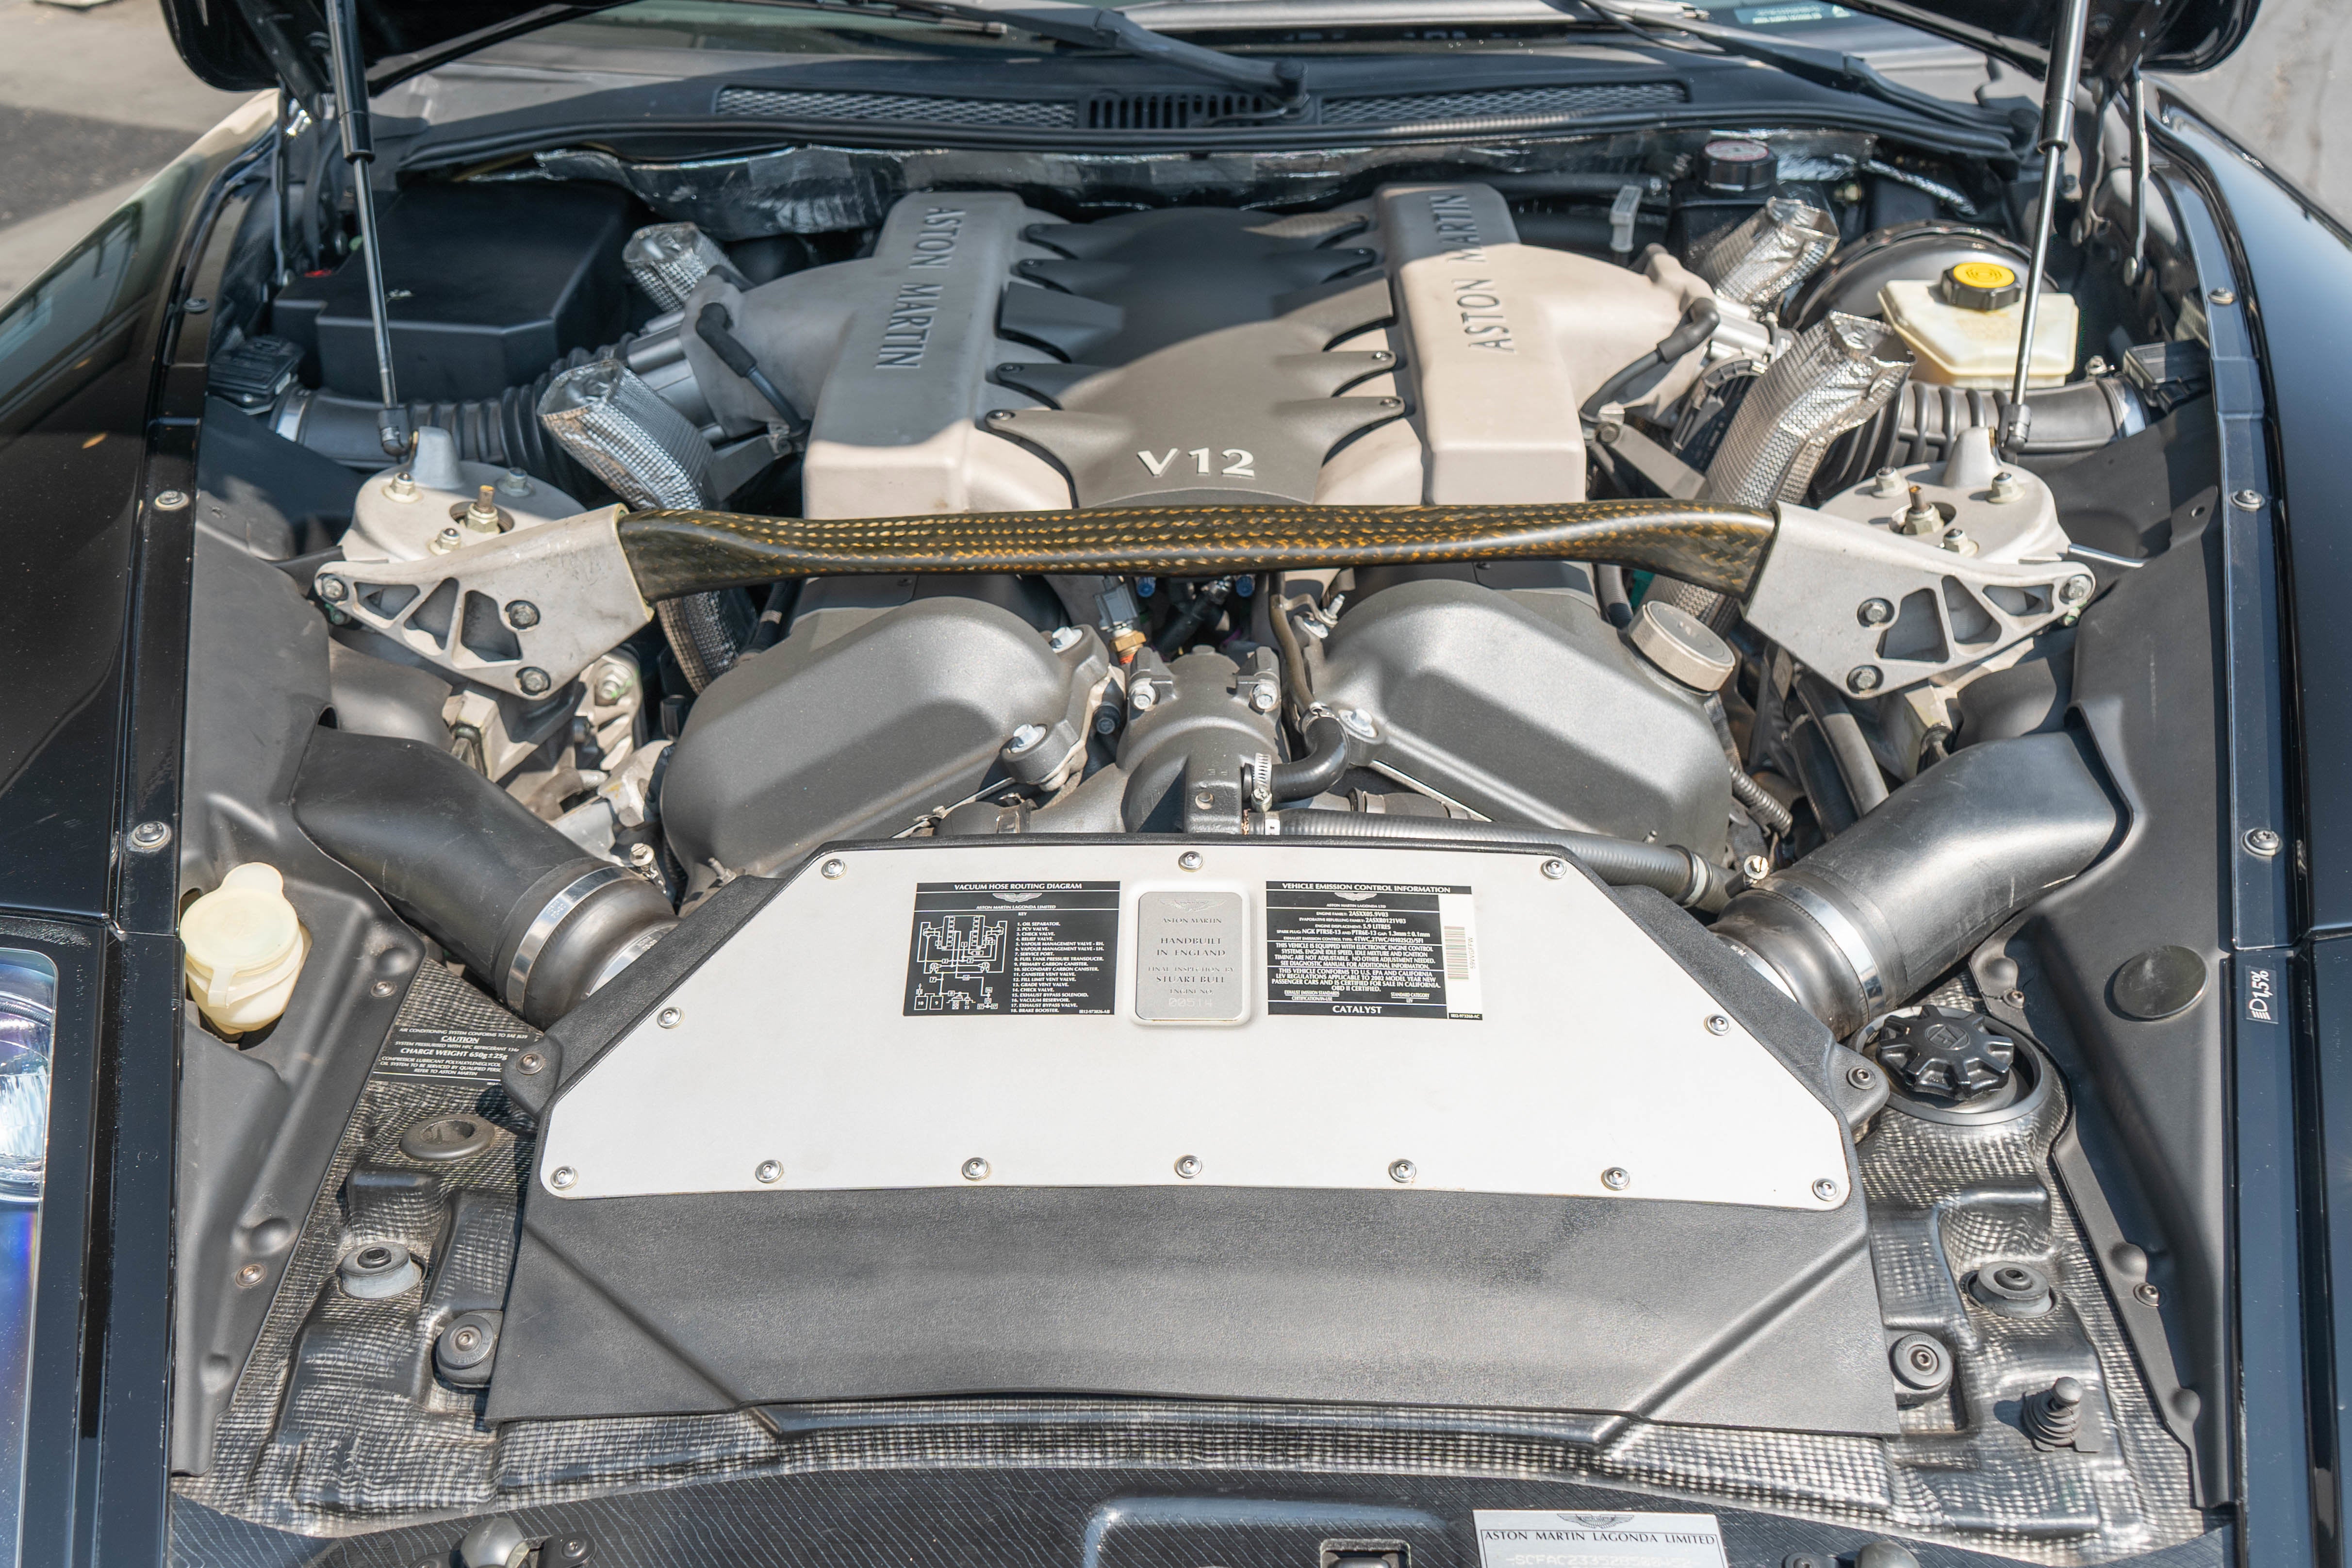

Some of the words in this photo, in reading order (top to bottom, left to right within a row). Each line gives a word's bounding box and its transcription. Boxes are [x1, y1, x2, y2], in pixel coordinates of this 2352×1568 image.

[909, 207, 966, 268] ASTON
[1428, 194, 1486, 263] MARTIN
[875, 284, 943, 368] MARTIN
[1453, 278, 1516, 353] ASTON
[1136, 447, 1255, 479] V12
[2251, 970, 2273, 998] 1,5%
[1332, 1005, 1382, 1013] CATALYST
[1485, 1531, 1528, 1540] ASTON
[1536, 1531, 1585, 1541] MARTIN
[1593, 1533, 1658, 1542] LAGONDA
[1665, 1535, 1715, 1544] LIMITED
